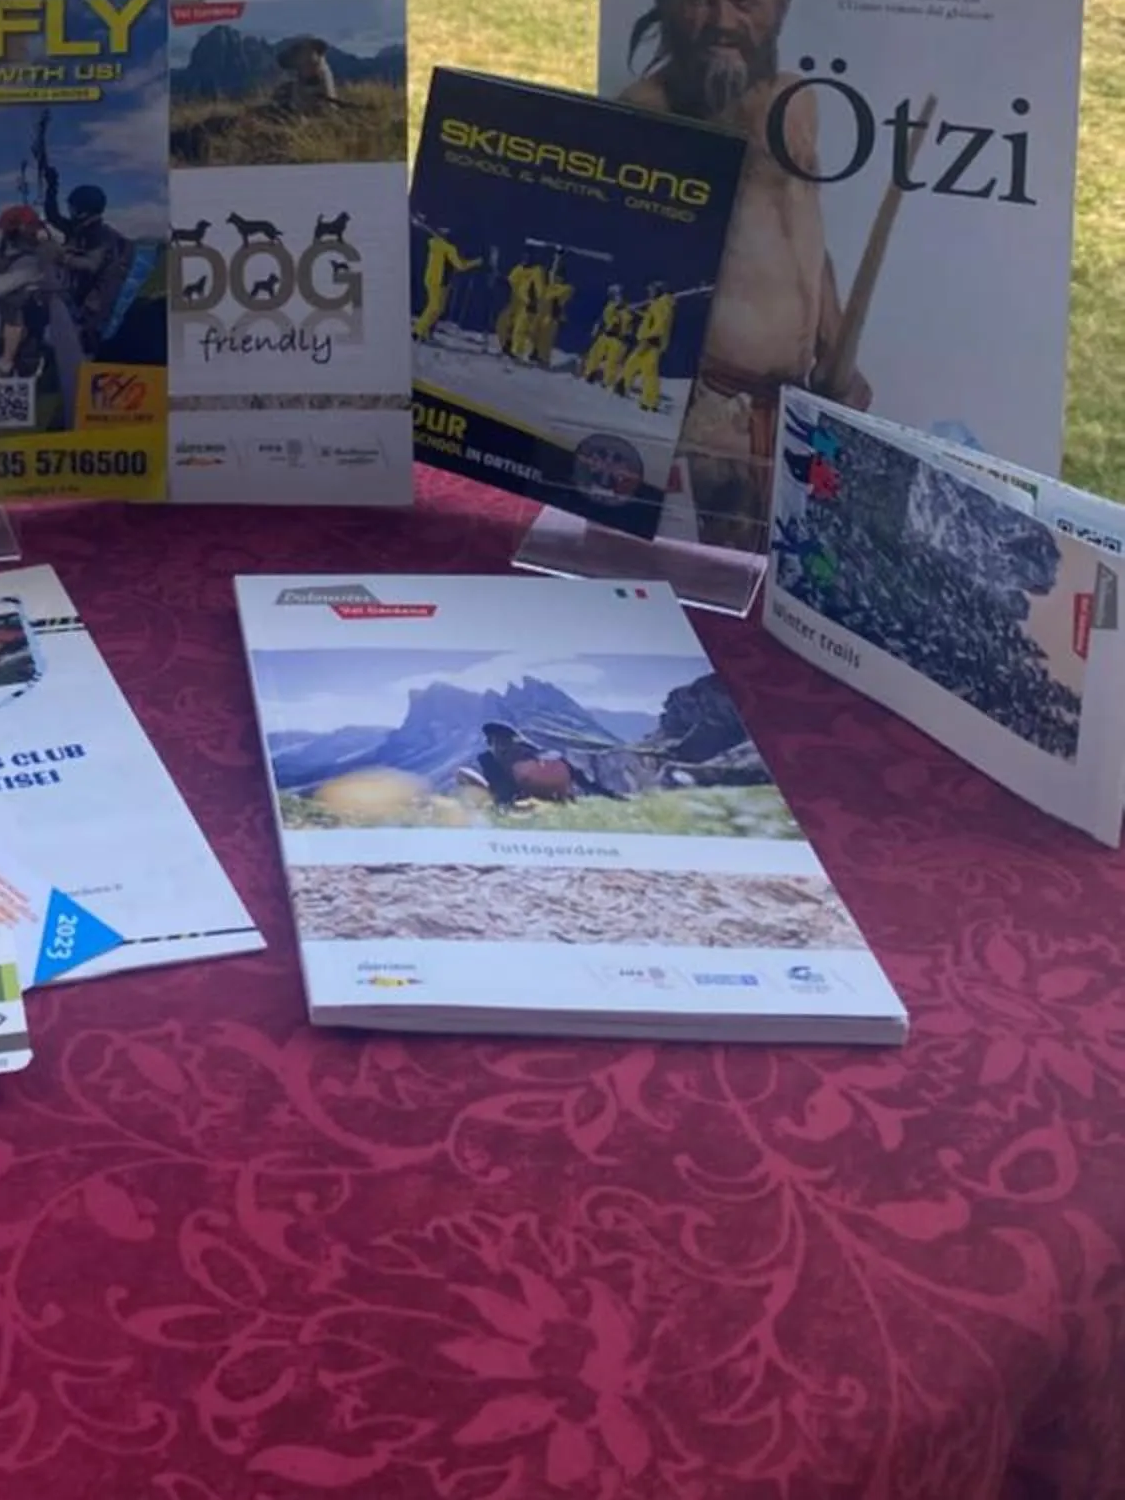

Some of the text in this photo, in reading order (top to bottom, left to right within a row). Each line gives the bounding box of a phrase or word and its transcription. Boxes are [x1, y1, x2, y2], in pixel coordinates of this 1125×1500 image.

[75, 62, 123, 80] US!
[766, 55, 1037, 207] Ötzi
[440, 118, 712, 205] SKISASLONG
[171, 241, 363, 312] DOG
[199, 325, 333, 365] friendly
[10, 743, 87, 768] CLUB
[45, 912, 80, 961] 2023
